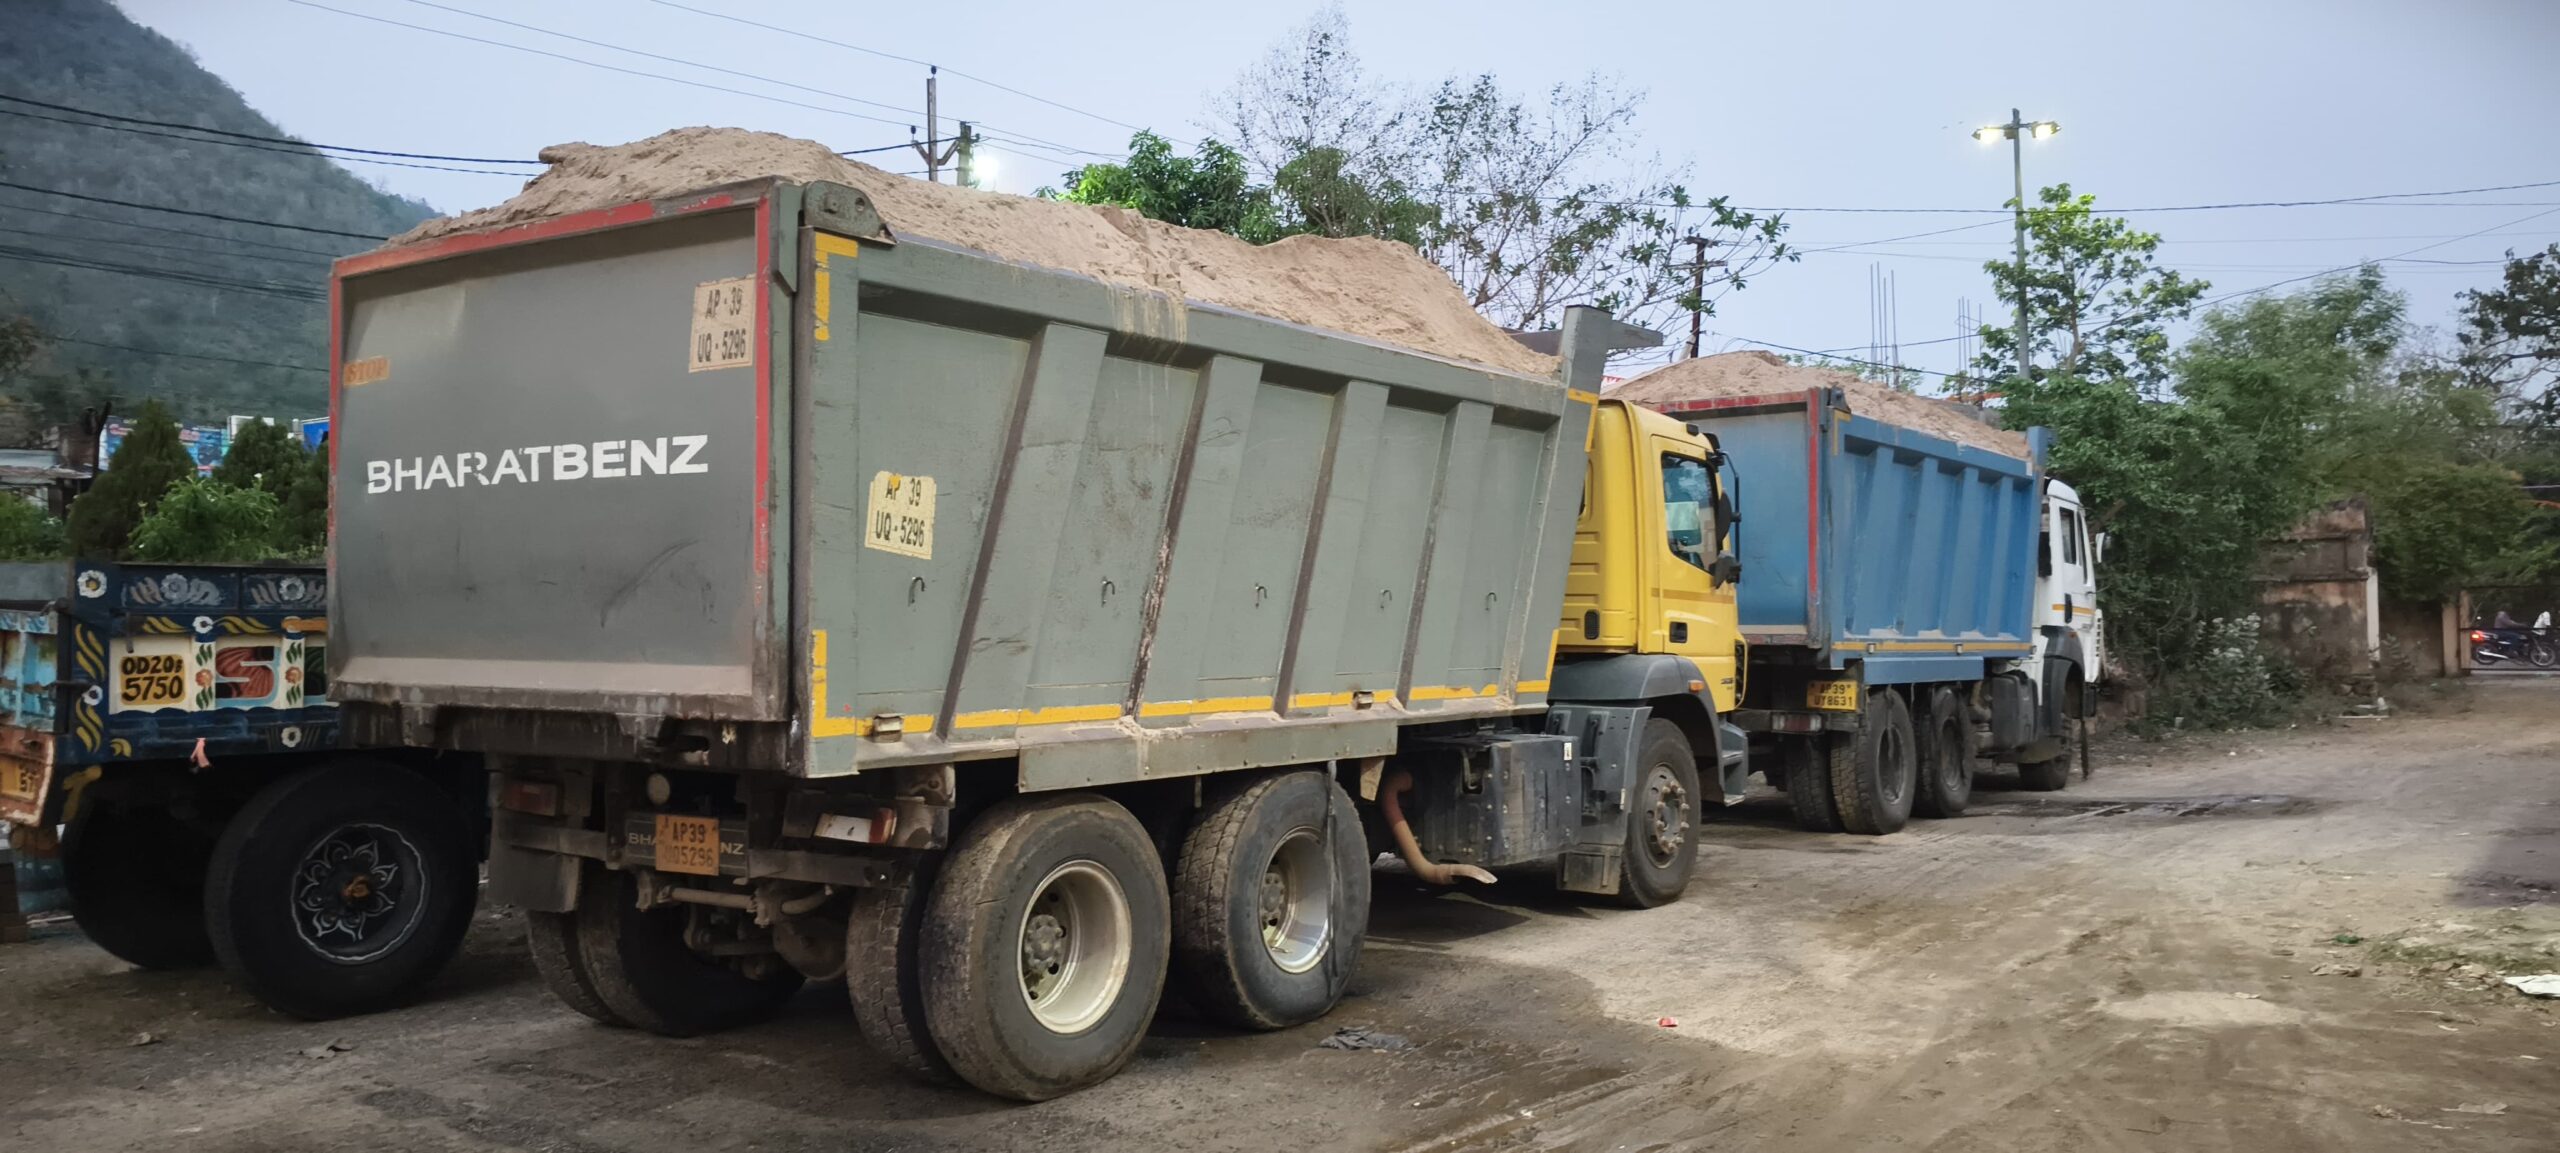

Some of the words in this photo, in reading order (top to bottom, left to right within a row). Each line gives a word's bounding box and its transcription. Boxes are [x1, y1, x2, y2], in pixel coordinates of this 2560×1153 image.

[705, 289, 721, 319] AP
[729, 286, 744, 316] 39
[697, 332, 713, 363] UQ
[721, 328, 747, 360] 5296
[346, 358, 387, 382] STOP
[367, 434, 709, 494] BHARATBENZ
[909, 477, 922, 507] 39
[875, 509, 892, 541] UQ
[900, 515, 925, 548] 5296
[121, 675, 184, 701] 5750
[672, 821, 706, 844] AP39
